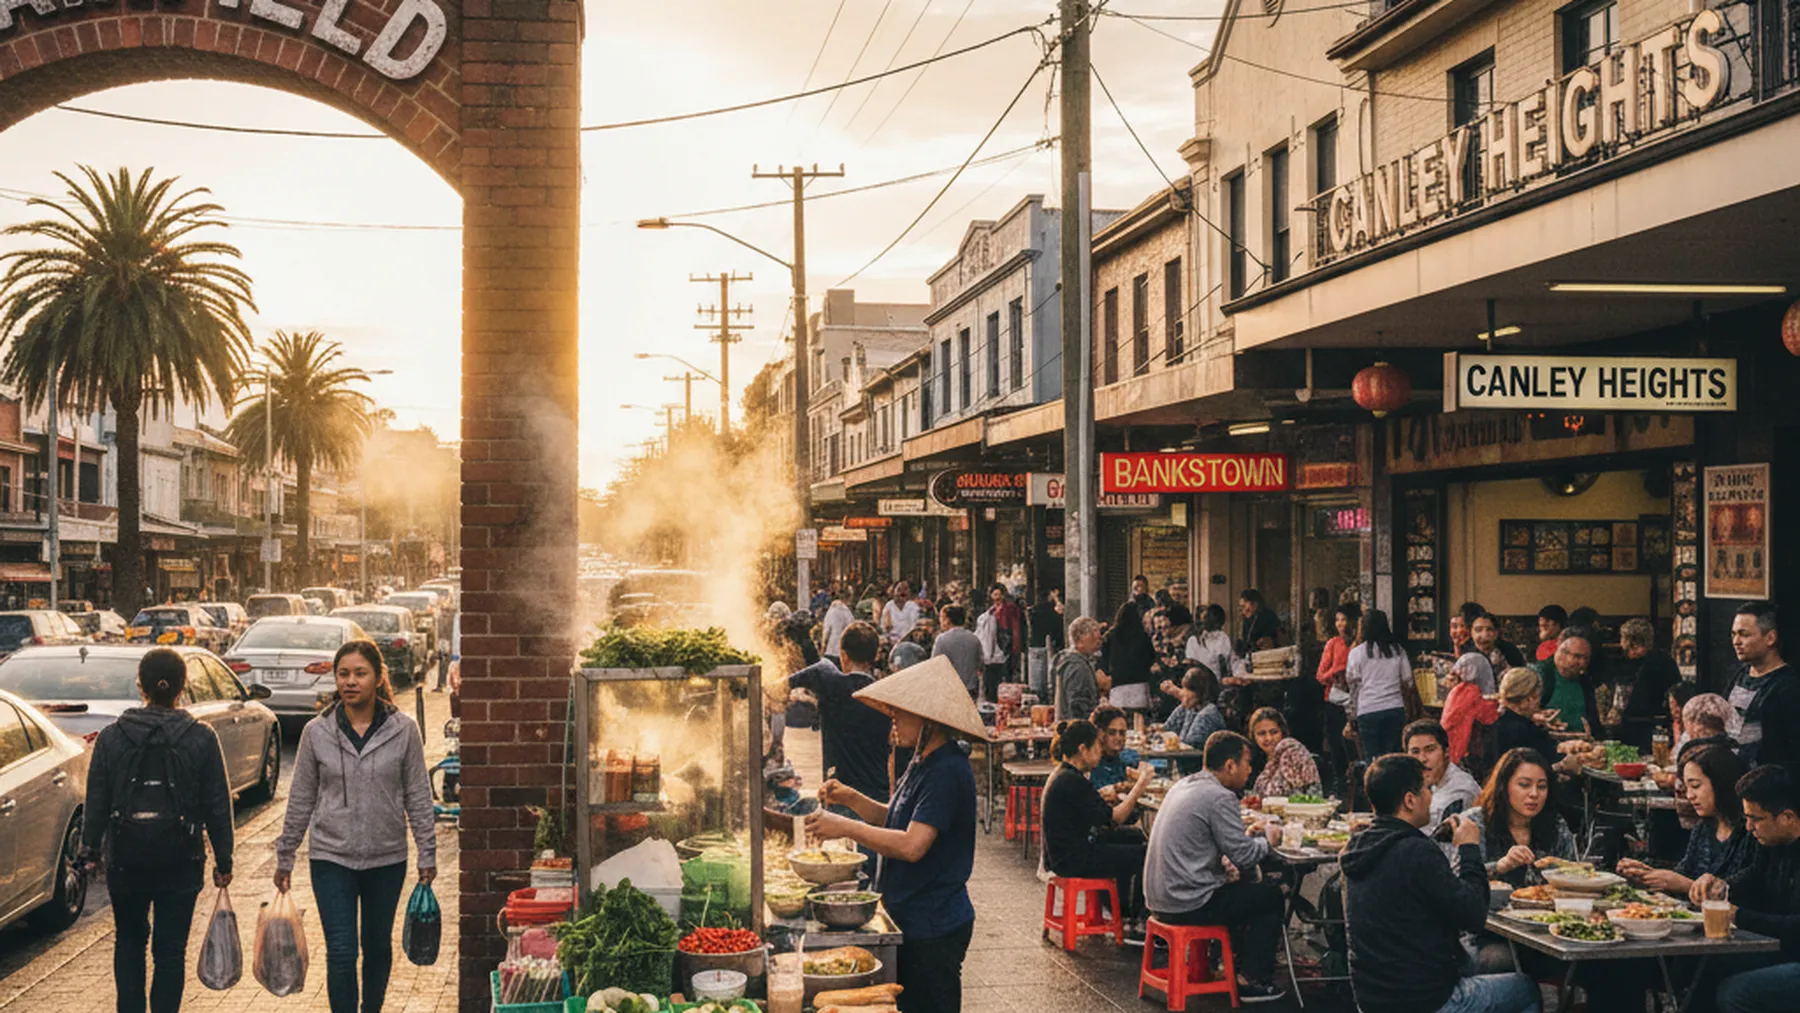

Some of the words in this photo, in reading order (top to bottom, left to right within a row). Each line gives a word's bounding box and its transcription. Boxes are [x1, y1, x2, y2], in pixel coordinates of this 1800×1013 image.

[1328, 126, 1471, 252] CANLEY
[1484, 9, 1729, 195] HEIGHTS
[1467, 364, 1587, 398] CANLEY
[1599, 367, 1727, 400] HEIGHTS
[1115, 457, 1284, 488] BANKSTOWN
